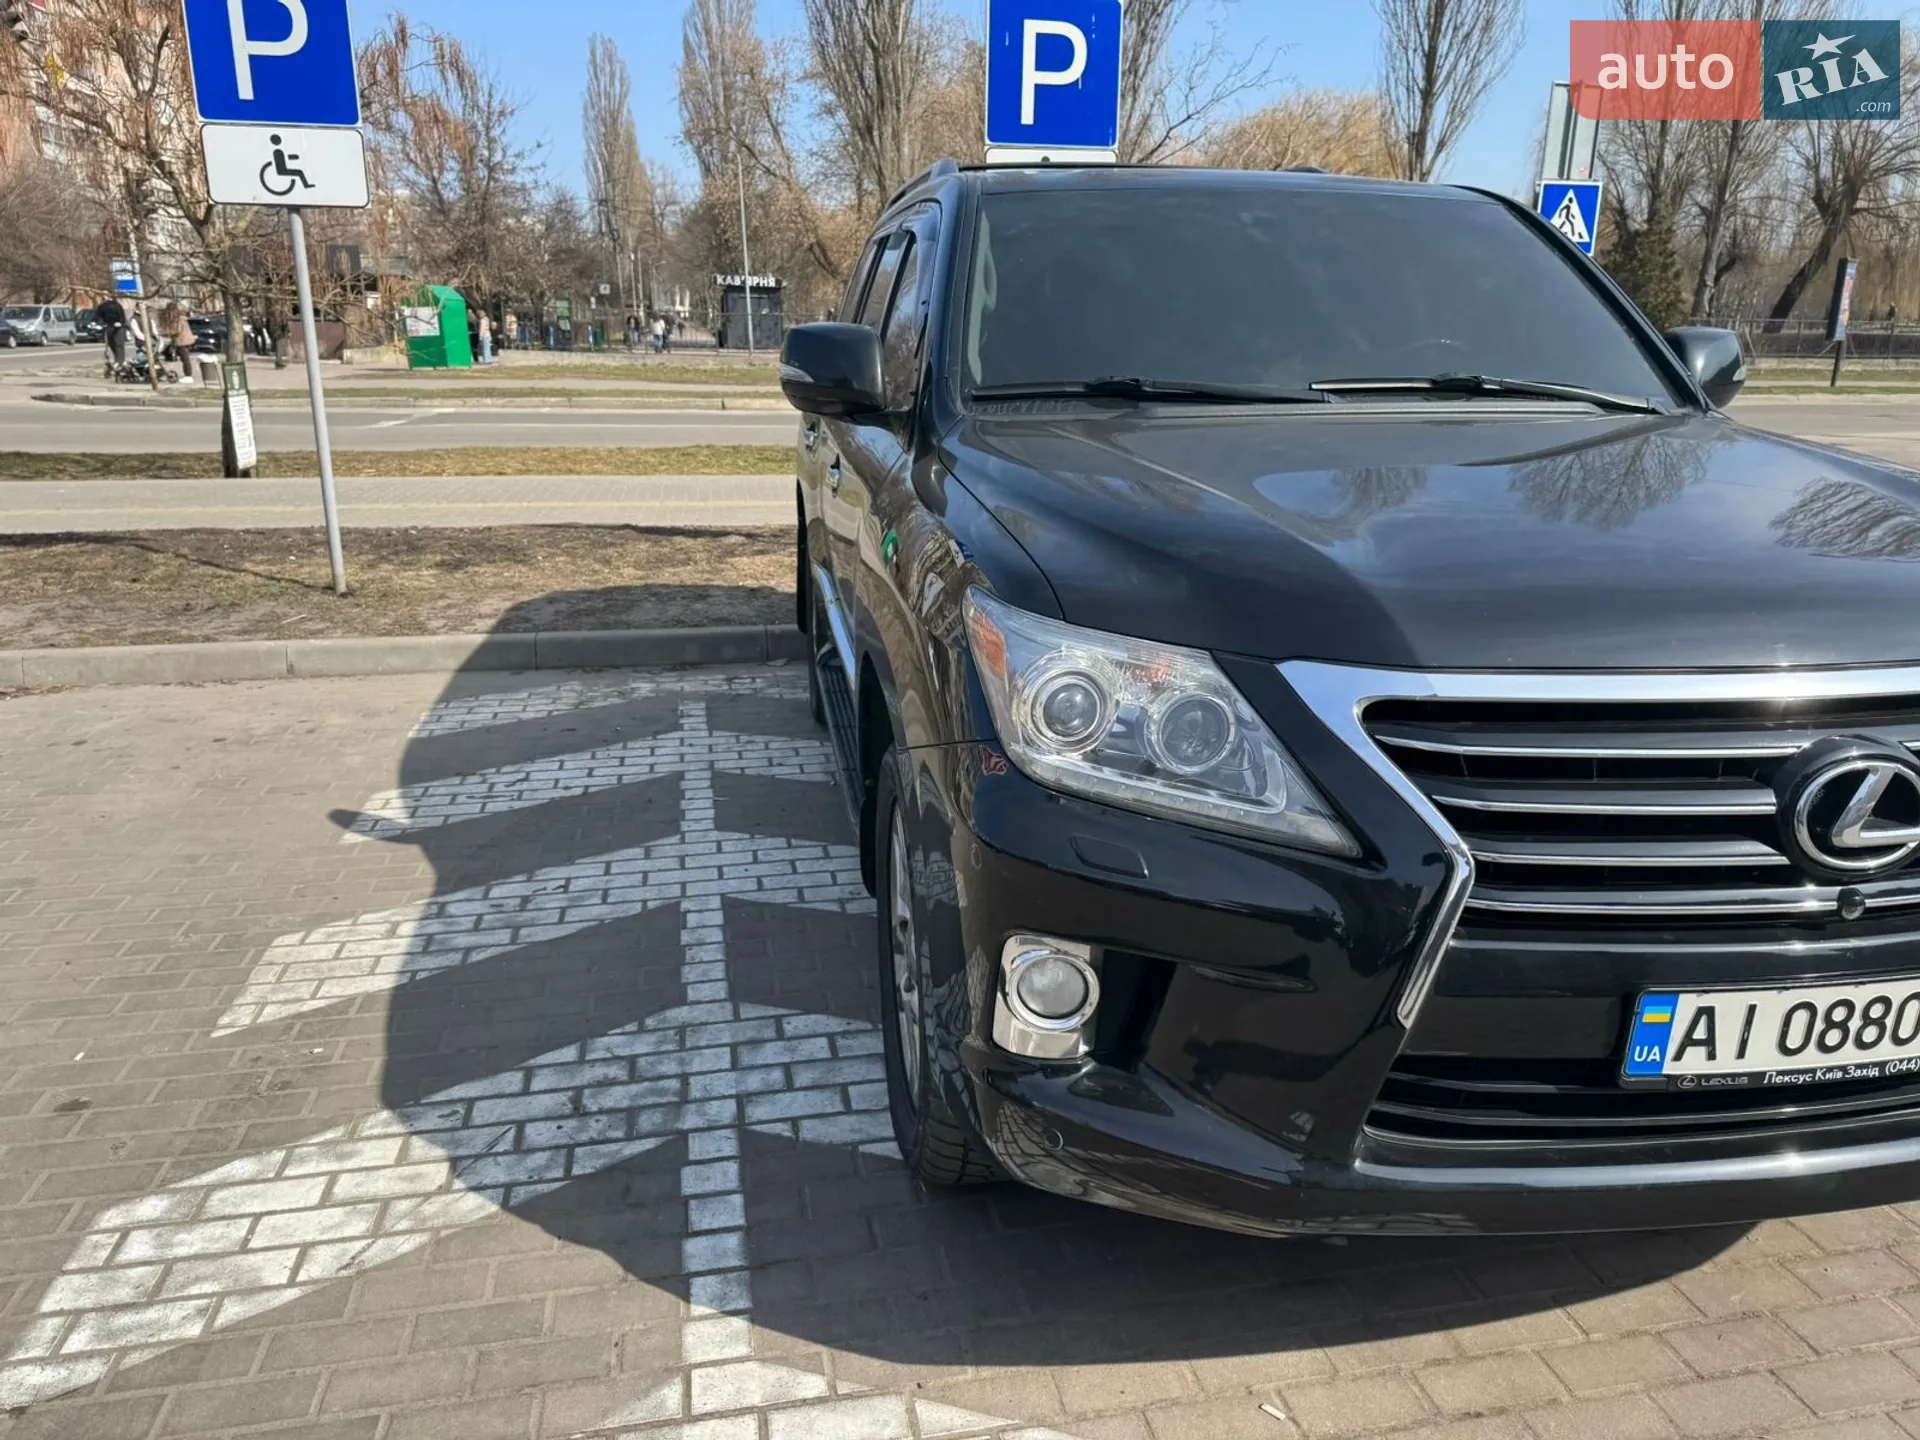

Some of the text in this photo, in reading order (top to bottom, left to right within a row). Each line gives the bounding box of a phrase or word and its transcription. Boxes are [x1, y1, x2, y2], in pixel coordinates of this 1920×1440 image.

[226, 0, 309, 101] P
[1020, 19, 1088, 125] P
[1777, 991, 1920, 1057] 0880
[1633, 1045, 1661, 1063] UA
[1763, 1058, 1920, 1084] Лексус Київ Захід (044)
[1701, 1076, 1749, 1086] LEXUS
